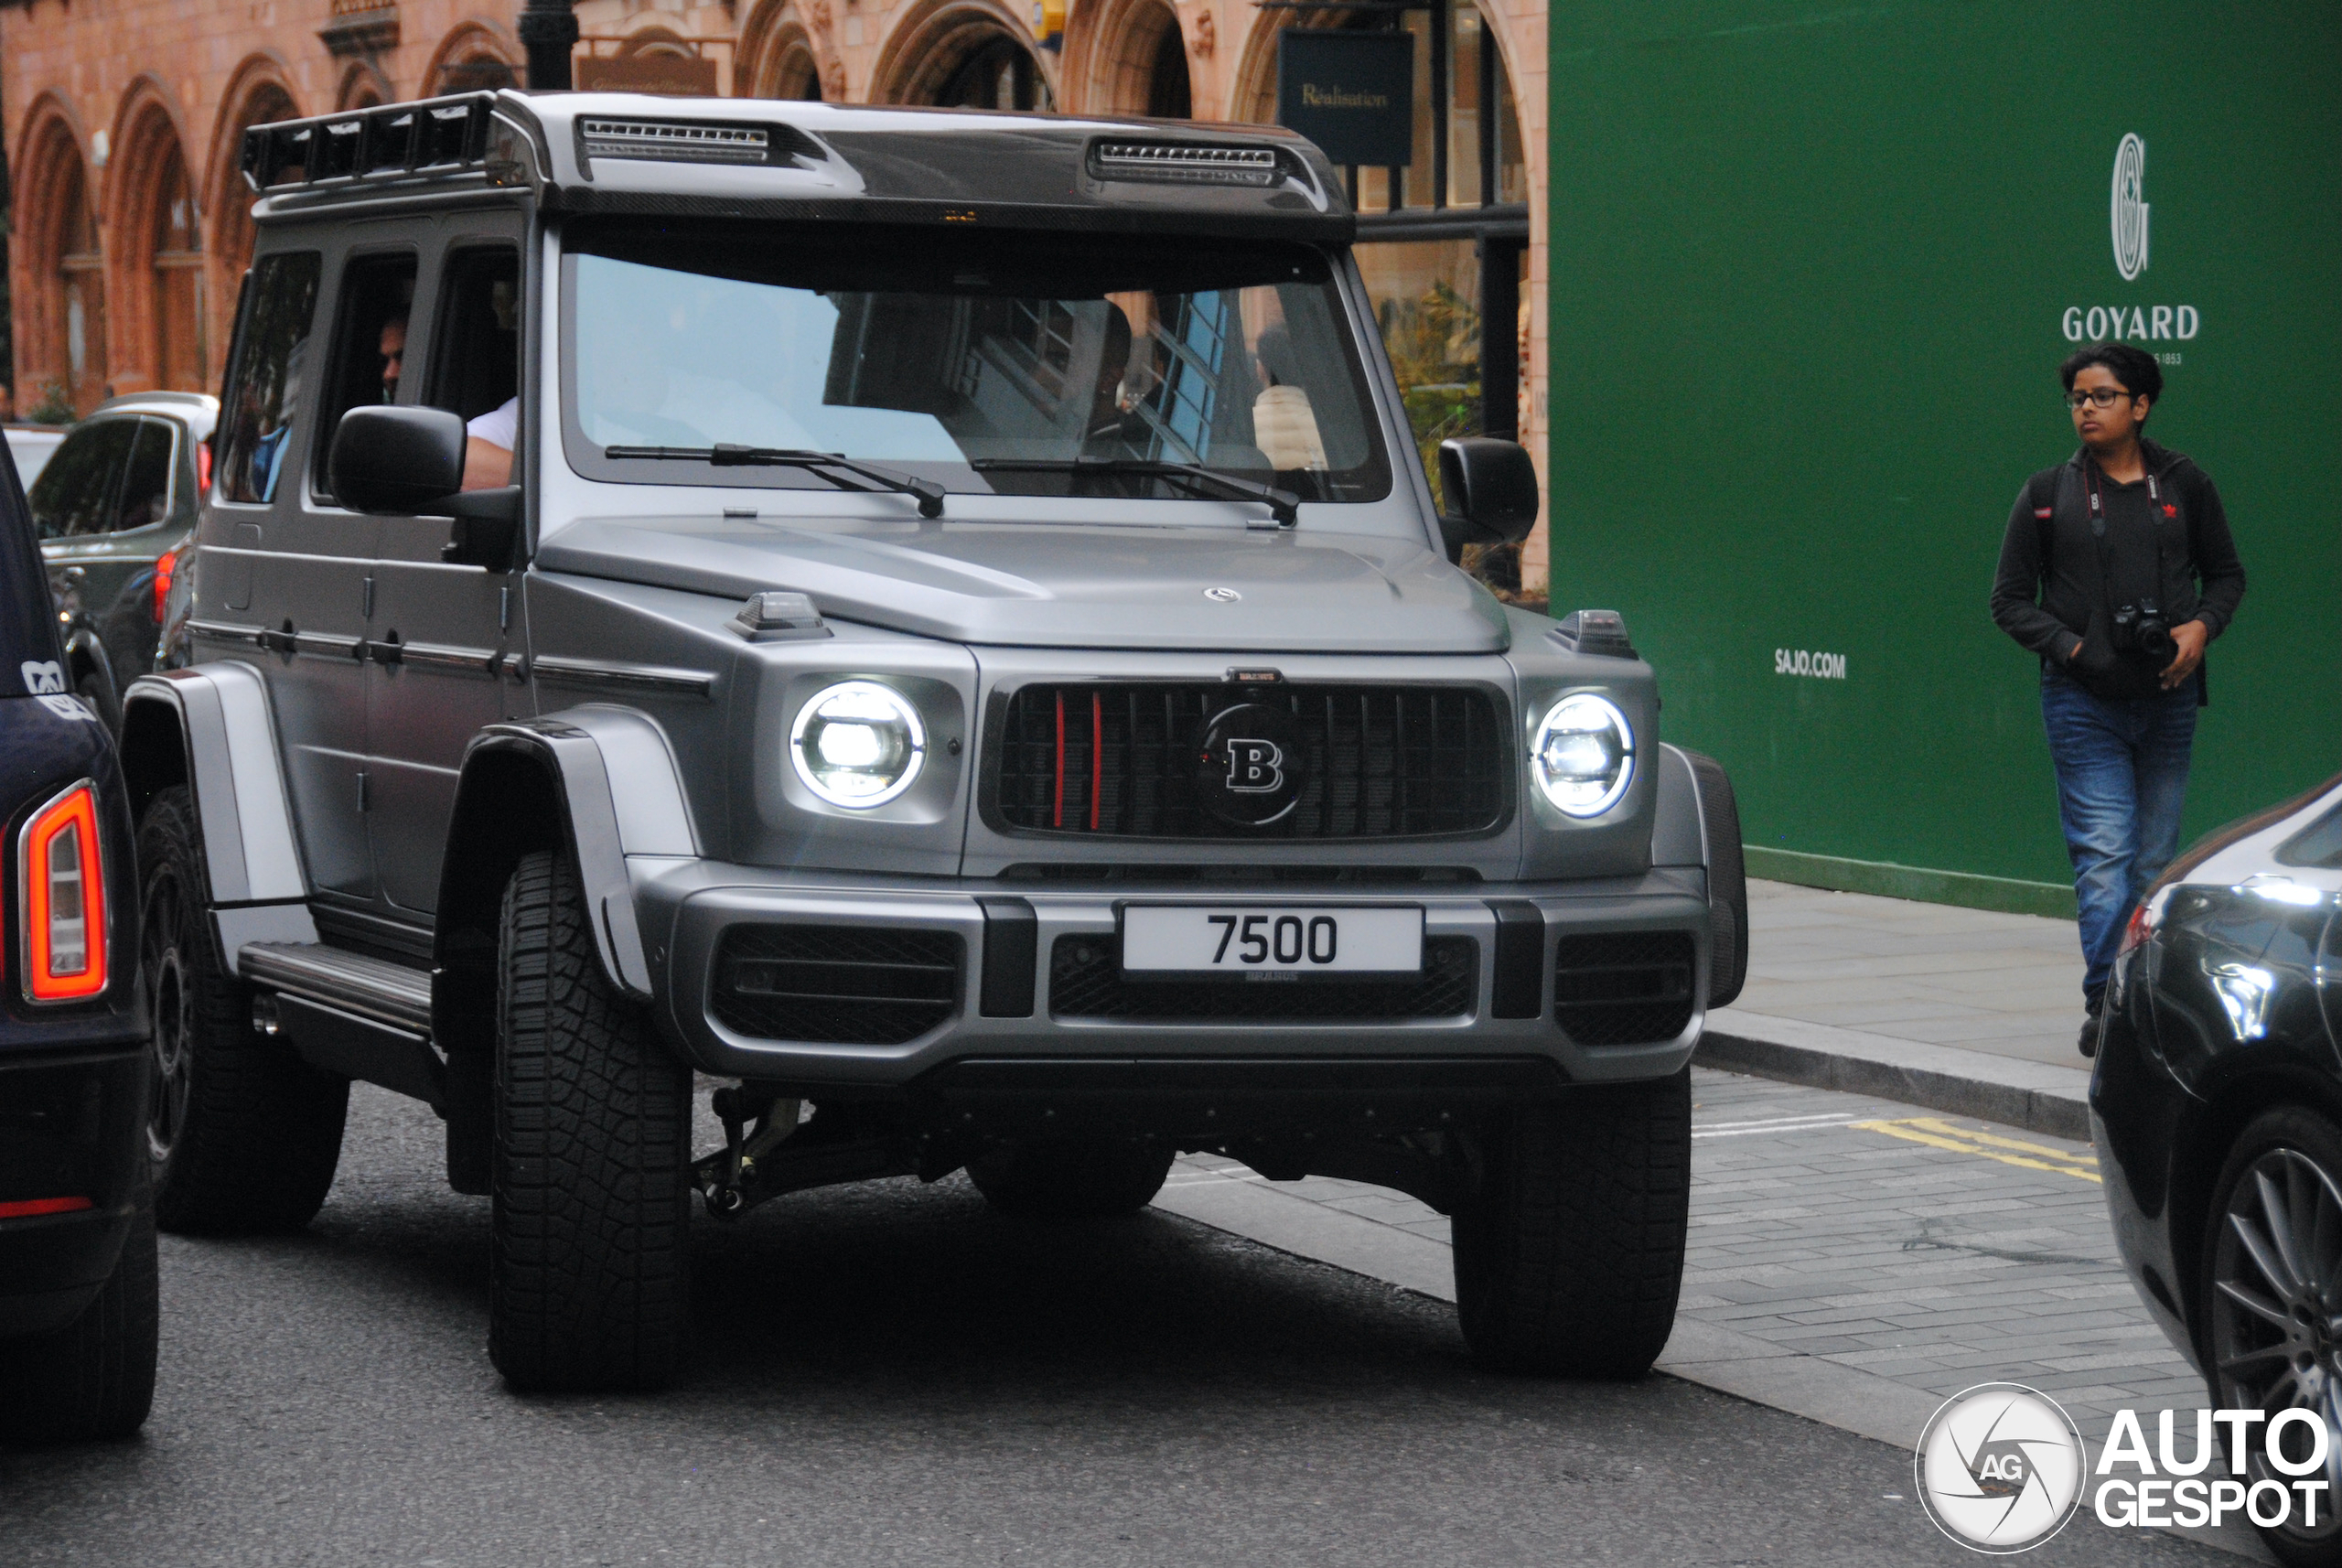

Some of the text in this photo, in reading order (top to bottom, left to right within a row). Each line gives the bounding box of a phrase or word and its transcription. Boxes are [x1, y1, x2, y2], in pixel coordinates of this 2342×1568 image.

[2062, 306, 2198, 341] GOYARD
[2162, 353, 2181, 364] 1853
[1775, 648, 1846, 679] SAJO.COM
[1226, 738, 1284, 793] B
[1208, 915, 1337, 963] 7500
